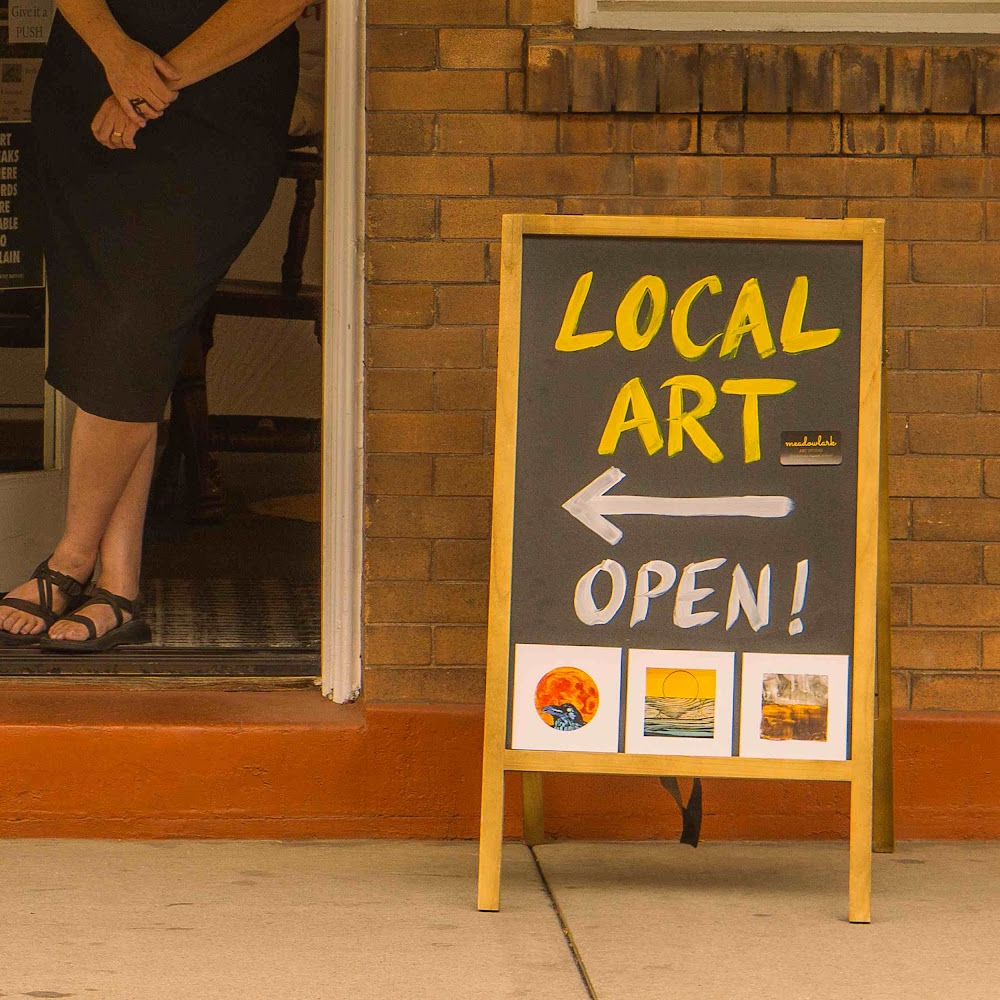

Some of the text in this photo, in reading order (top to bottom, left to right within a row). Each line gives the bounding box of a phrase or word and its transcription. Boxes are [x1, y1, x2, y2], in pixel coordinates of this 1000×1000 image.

[11, 6, 32, 17] Give
[16, 26, 43, 38] PUSH
[554, 270, 841, 361] LOCAL
[597, 374, 797, 464] ART
[785, 434, 838, 447] meadowlark
